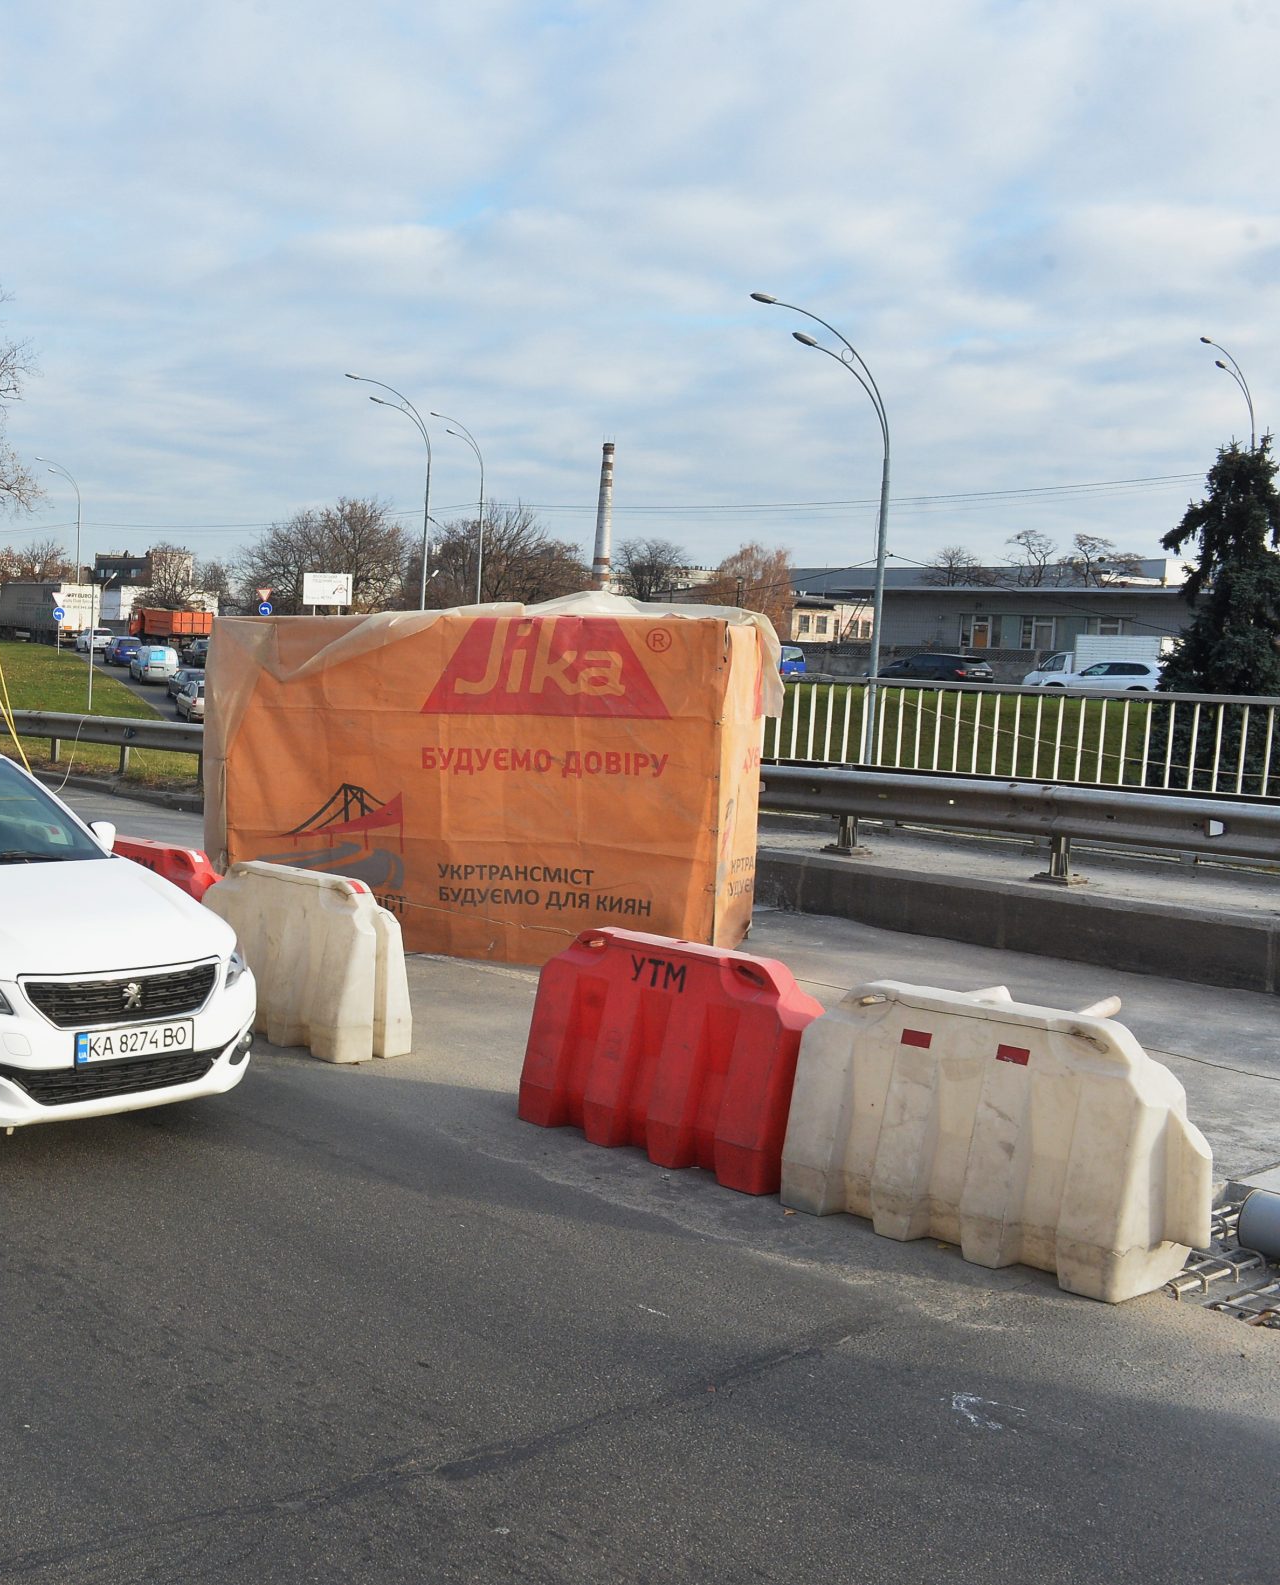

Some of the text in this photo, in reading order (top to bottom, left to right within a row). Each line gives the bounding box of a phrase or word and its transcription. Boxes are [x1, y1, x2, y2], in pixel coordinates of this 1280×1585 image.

[421, 747, 670, 779] БУДУЄМО ДОВІРУ
[437, 863, 594, 886] УКРТРАНСМІСТ
[438, 886, 652, 917] БУДУЄМО ДЛЯ КИЯН
[631, 954, 687, 993] УТМ
[89, 1026, 187, 1058] KA 8274 BO
